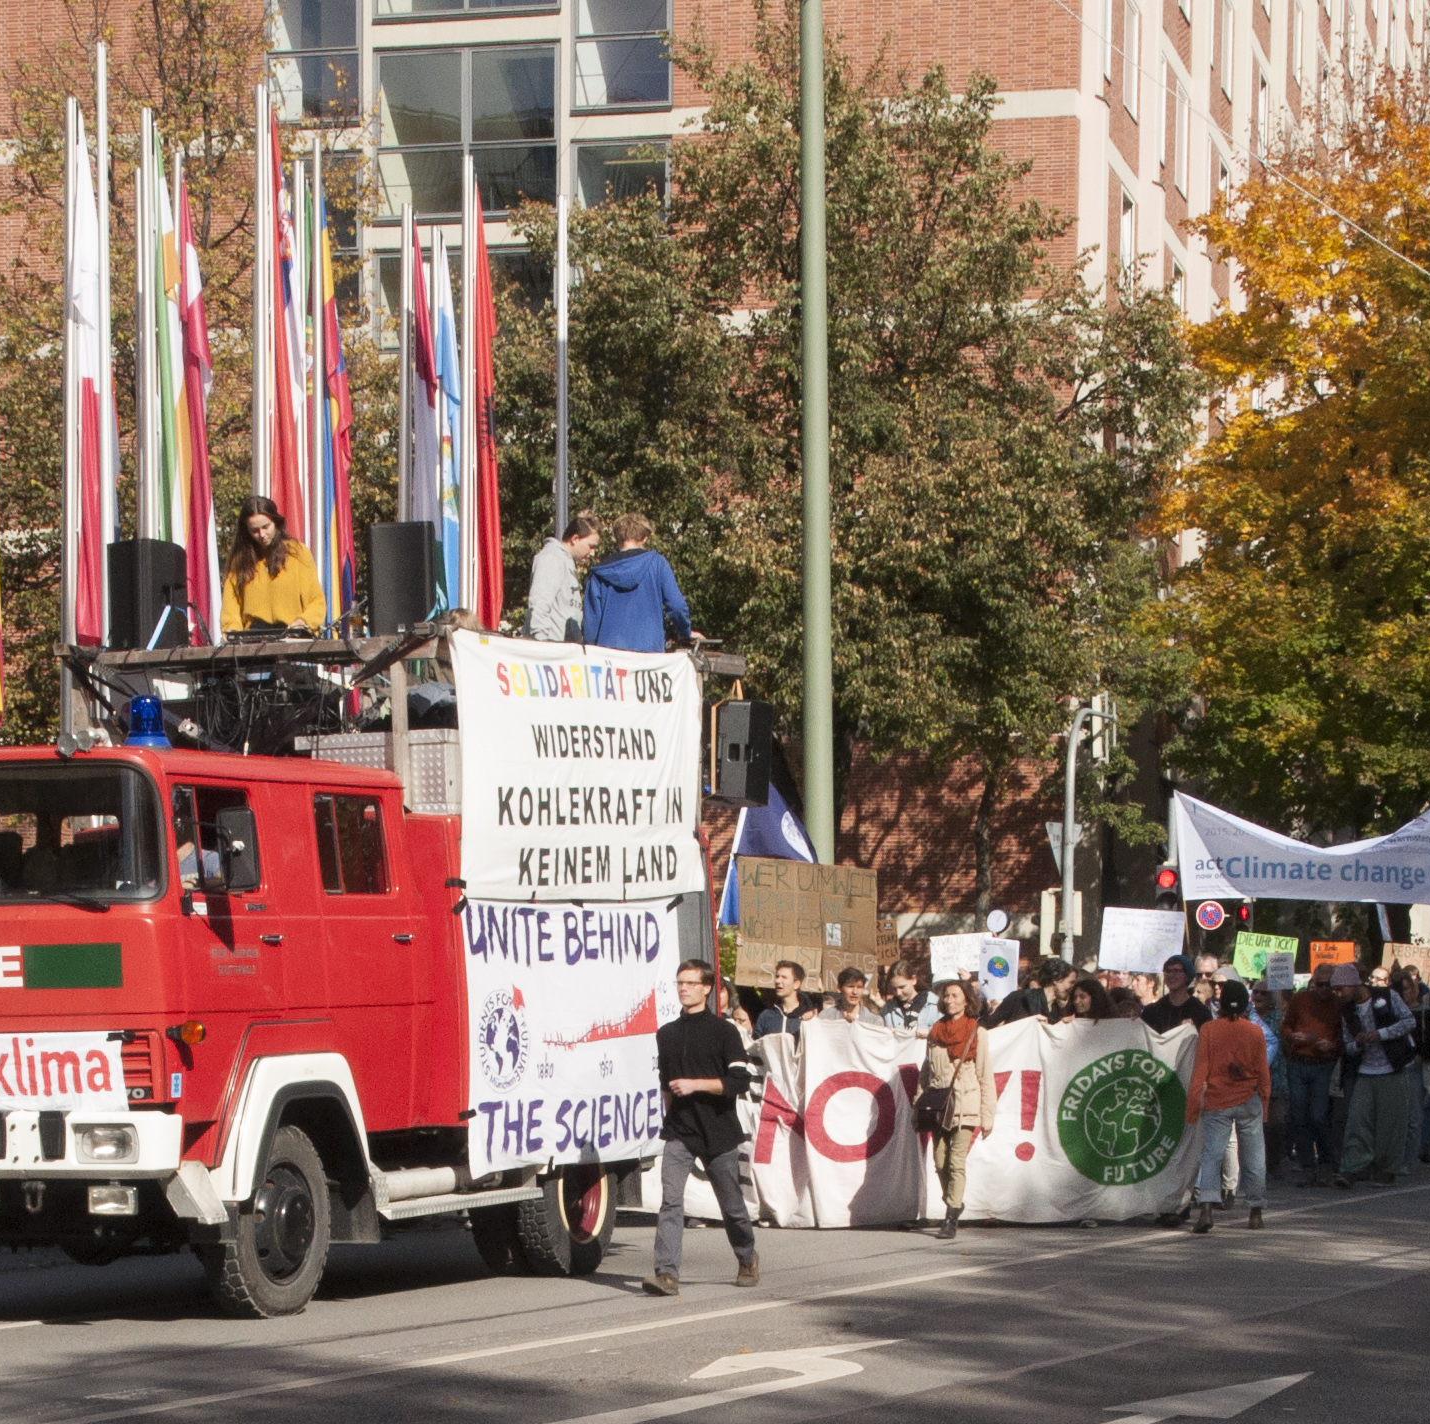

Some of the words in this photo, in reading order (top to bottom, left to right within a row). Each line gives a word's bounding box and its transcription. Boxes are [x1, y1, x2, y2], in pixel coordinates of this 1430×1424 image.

[497, 660, 627, 701] SOLIDARITÄT
[635, 670, 673, 703] UND
[531, 724, 656, 760] WIDERSTAND
[497, 786, 656, 826] KOHLEKRAFT
[665, 787, 683, 824] IN
[518, 845, 611, 886] KEINEM
[622, 845, 677, 884] LAND
[742, 862, 791, 889] WER
[1194, 855, 1225, 872] act
[1225, 856, 1332, 880] Climate
[1339, 857, 1426, 890] change
[465, 904, 554, 968] UNITE
[563, 910, 659, 965] BEHIND
[1237, 933, 1254, 946] DIE
[1255, 935, 1271, 948] UHR
[1274, 937, 1297, 950] TICKT
[1062, 1054, 1125, 1121] FRIDAYS
[1130, 1053, 1166, 1084] FOR
[478, 1099, 545, 1164] THE
[1103, 1135, 1175, 1182] FUTURE
